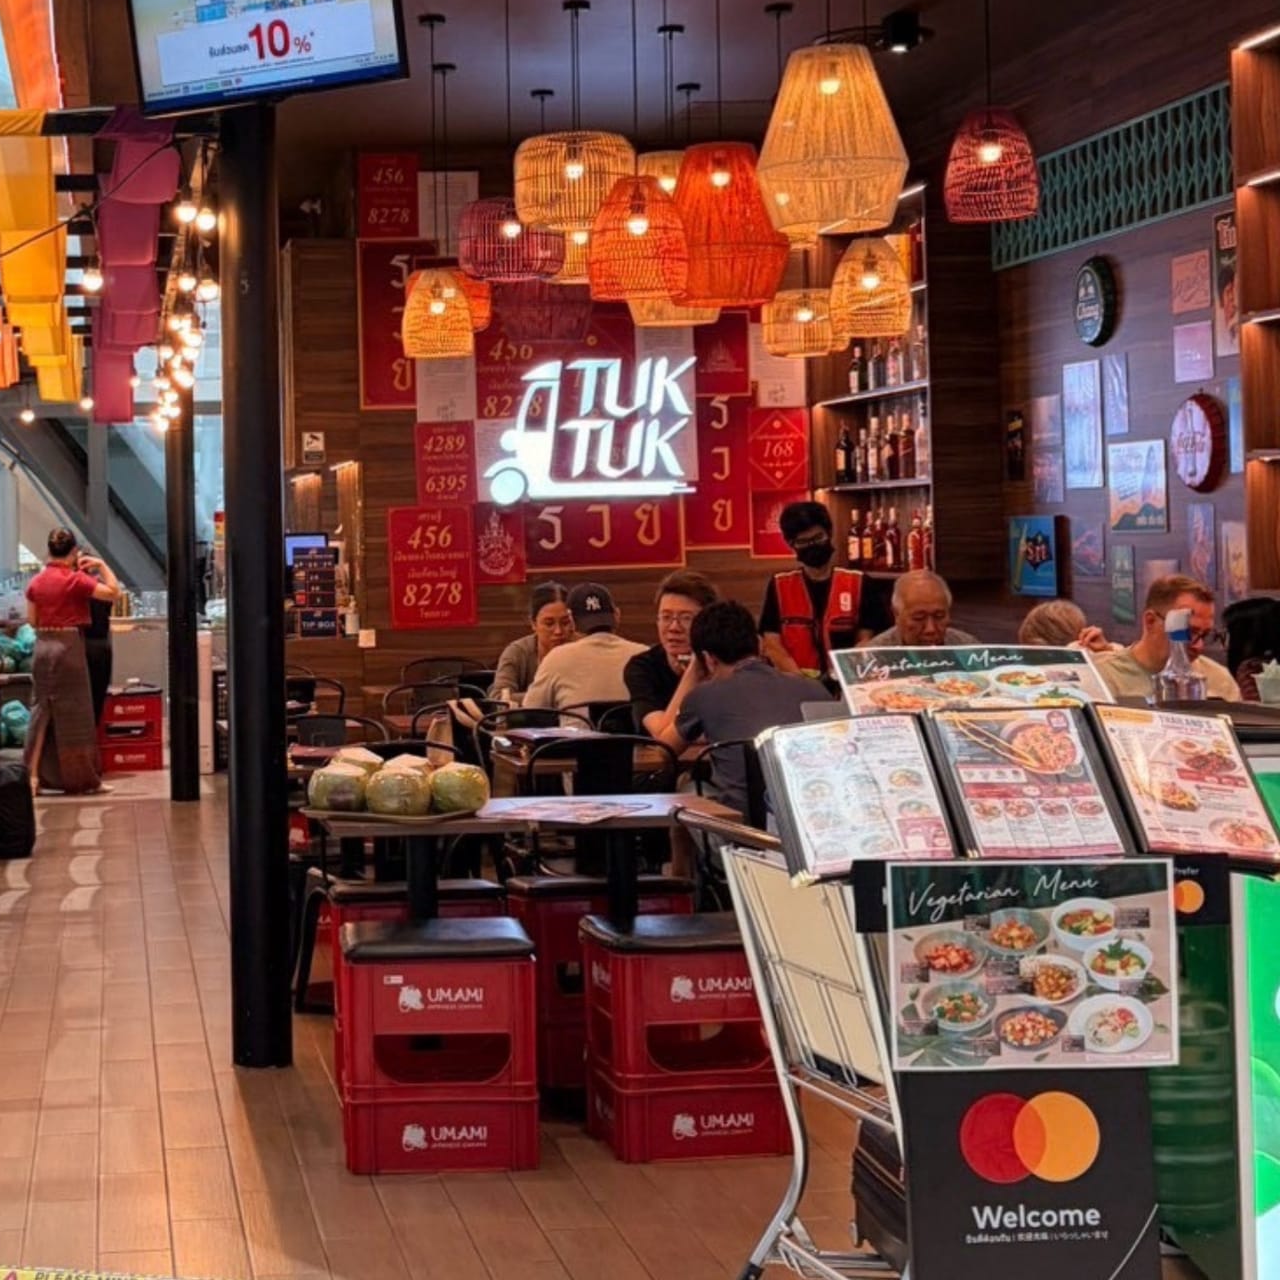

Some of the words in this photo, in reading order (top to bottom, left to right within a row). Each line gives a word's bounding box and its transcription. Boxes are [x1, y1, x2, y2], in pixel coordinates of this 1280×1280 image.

[564, 355, 698, 418] TUK
[483, 395, 544, 419] 828
[423, 434, 467, 454] 4289
[558, 417, 689, 479] TUK
[762, 439, 795, 458] 168
[424, 474, 468, 492] 6395
[406, 525, 453, 550] 456
[537, 503, 661, 551] รวย
[402, 580, 463, 606] 8278
[838, 592, 852, 611] 9
[856, 654, 955, 681] Vegetarian
[967, 648, 1025, 667] Menu
[908, 880, 1020, 923] Vegetarian
[1032, 868, 1099, 900] Menu
[426, 988, 484, 1003] UMAMI
[700, 1112, 754, 1129] UMAMI
[430, 1126, 488, 1141] UMAMI
[971, 1203, 1102, 1230] Welcome
